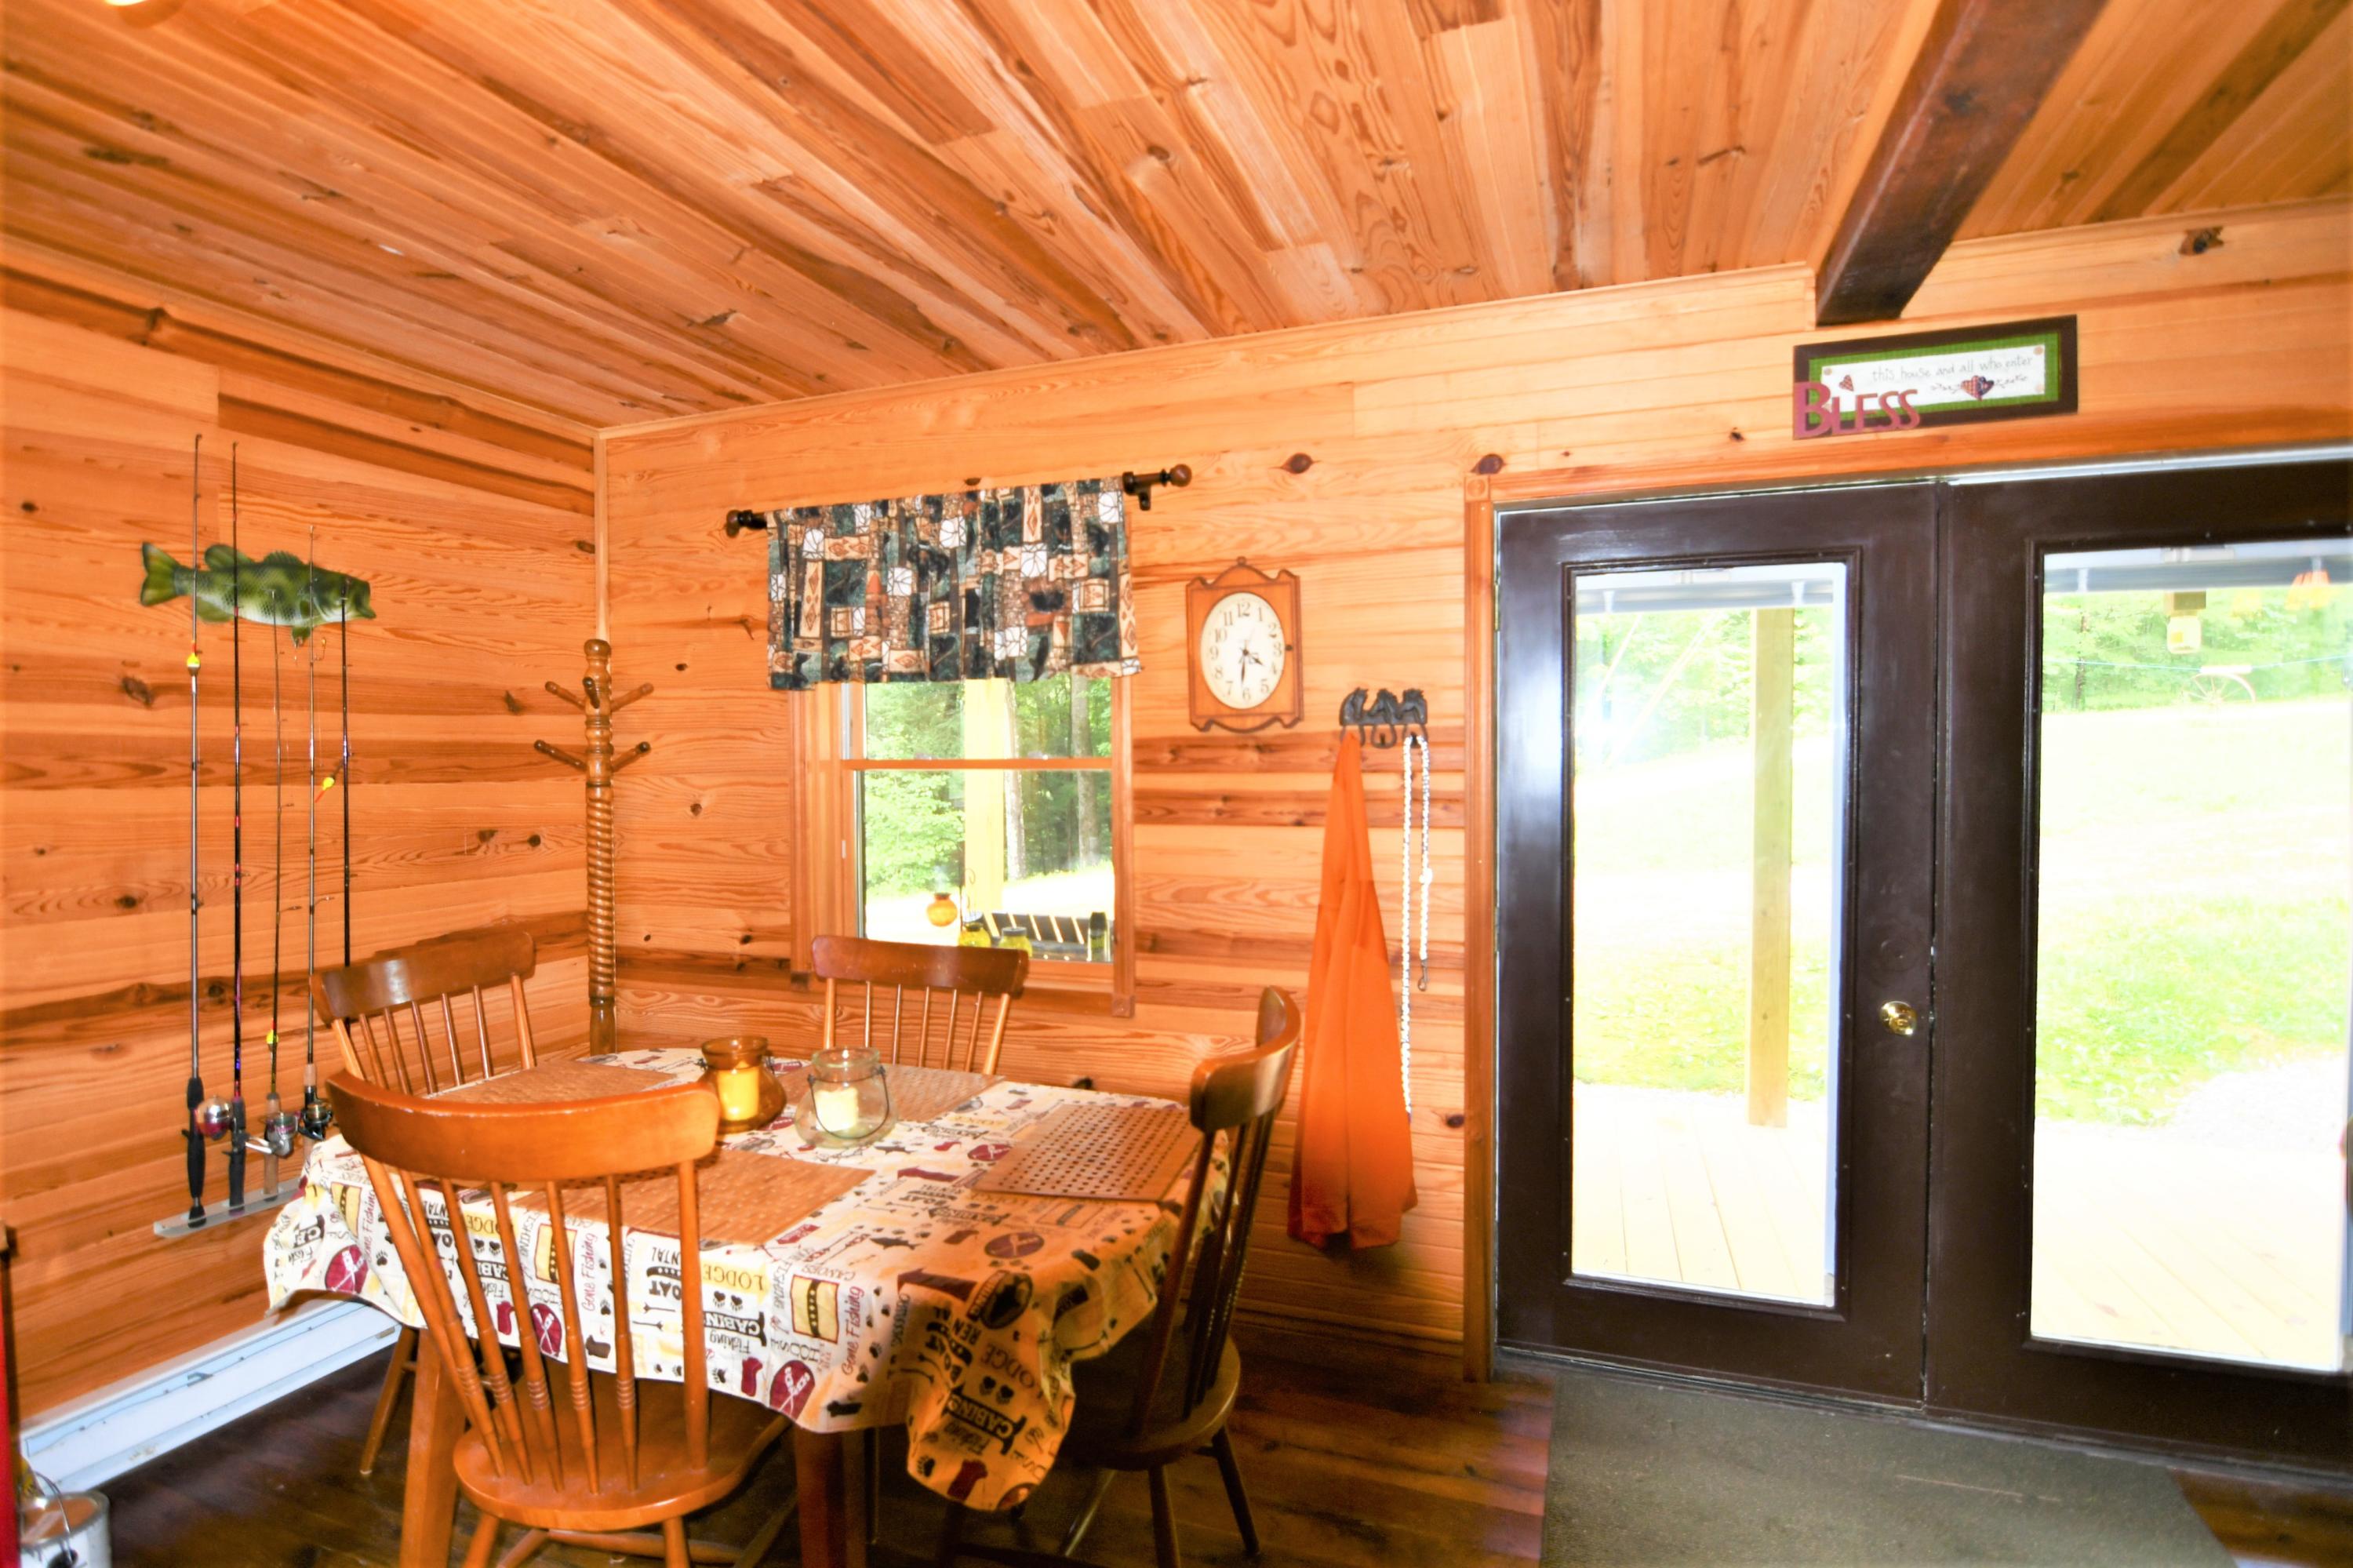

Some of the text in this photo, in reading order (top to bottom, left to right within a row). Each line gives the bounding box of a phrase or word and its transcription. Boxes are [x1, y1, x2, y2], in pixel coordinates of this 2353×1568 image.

[1872, 355, 2034, 383] this house and all who enter
[1793, 382, 1922, 440] BLESS
[1237, 601, 1251, 618] 12
[1257, 606, 1263, 622] 1
[1223, 611, 1234, 627] 11
[1214, 628, 1228, 643] 10
[1268, 622, 1277, 638] 2
[1209, 646, 1219, 660] 9
[1273, 642, 1282, 657] 3
[1213, 665, 1224, 679] 8
[1225, 680, 1234, 696] 7
[1260, 678, 1270, 694] 5
[1242, 688, 1252, 701] 6
[581, 1231, 598, 1312] Gone Fishing
[703, 1265, 765, 1292] LODGE
[649, 1280, 681, 1301] OAT
[842, 1285, 864, 1377] Gone Fishing
[709, 1329, 751, 1355] Fishing
